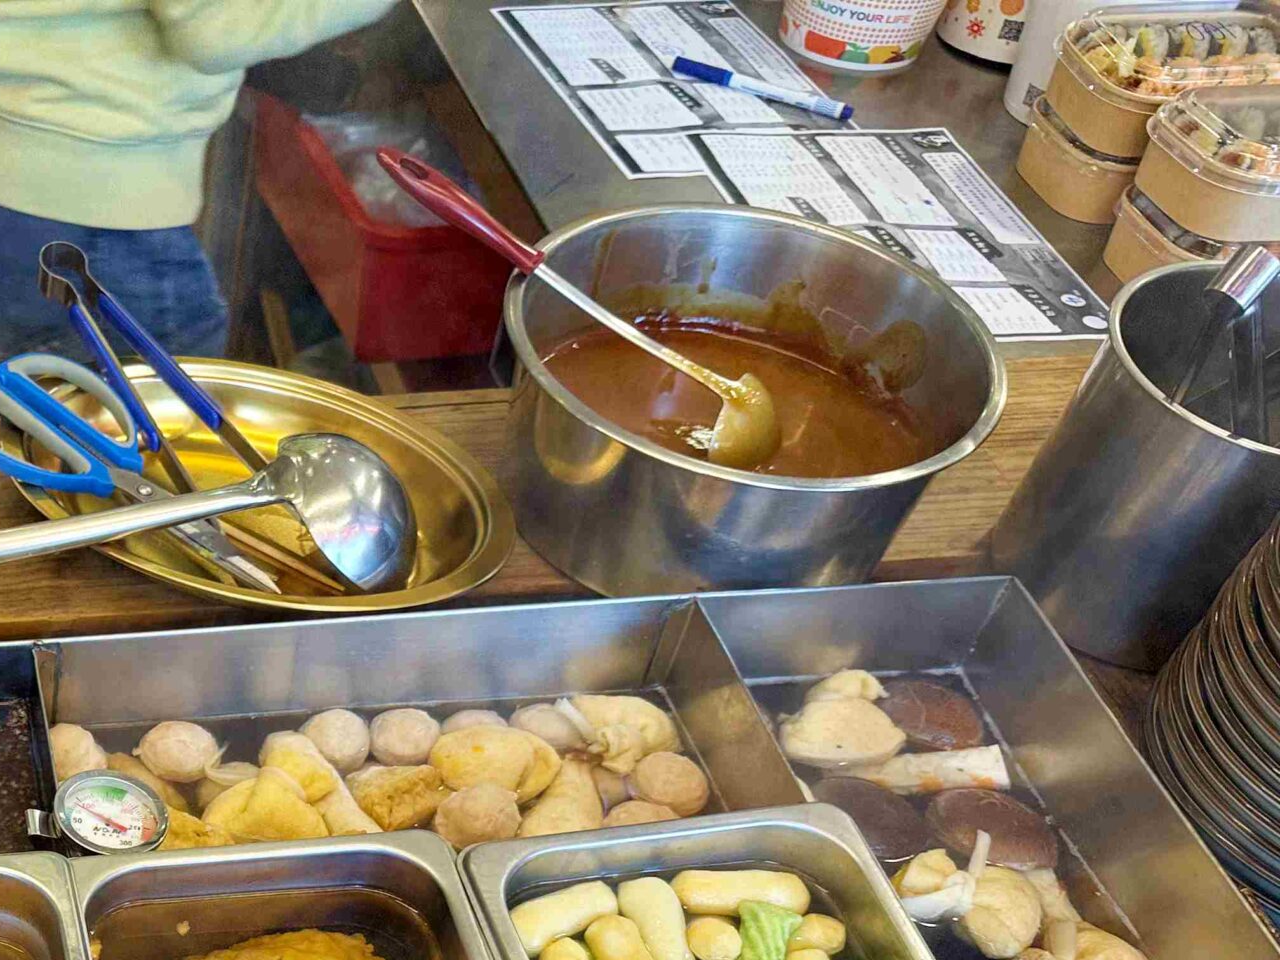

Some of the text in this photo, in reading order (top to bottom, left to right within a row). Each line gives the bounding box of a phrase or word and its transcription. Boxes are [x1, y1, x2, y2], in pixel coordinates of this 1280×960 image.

[812, 0, 911, 24] ENJOY YOUR LIFE
